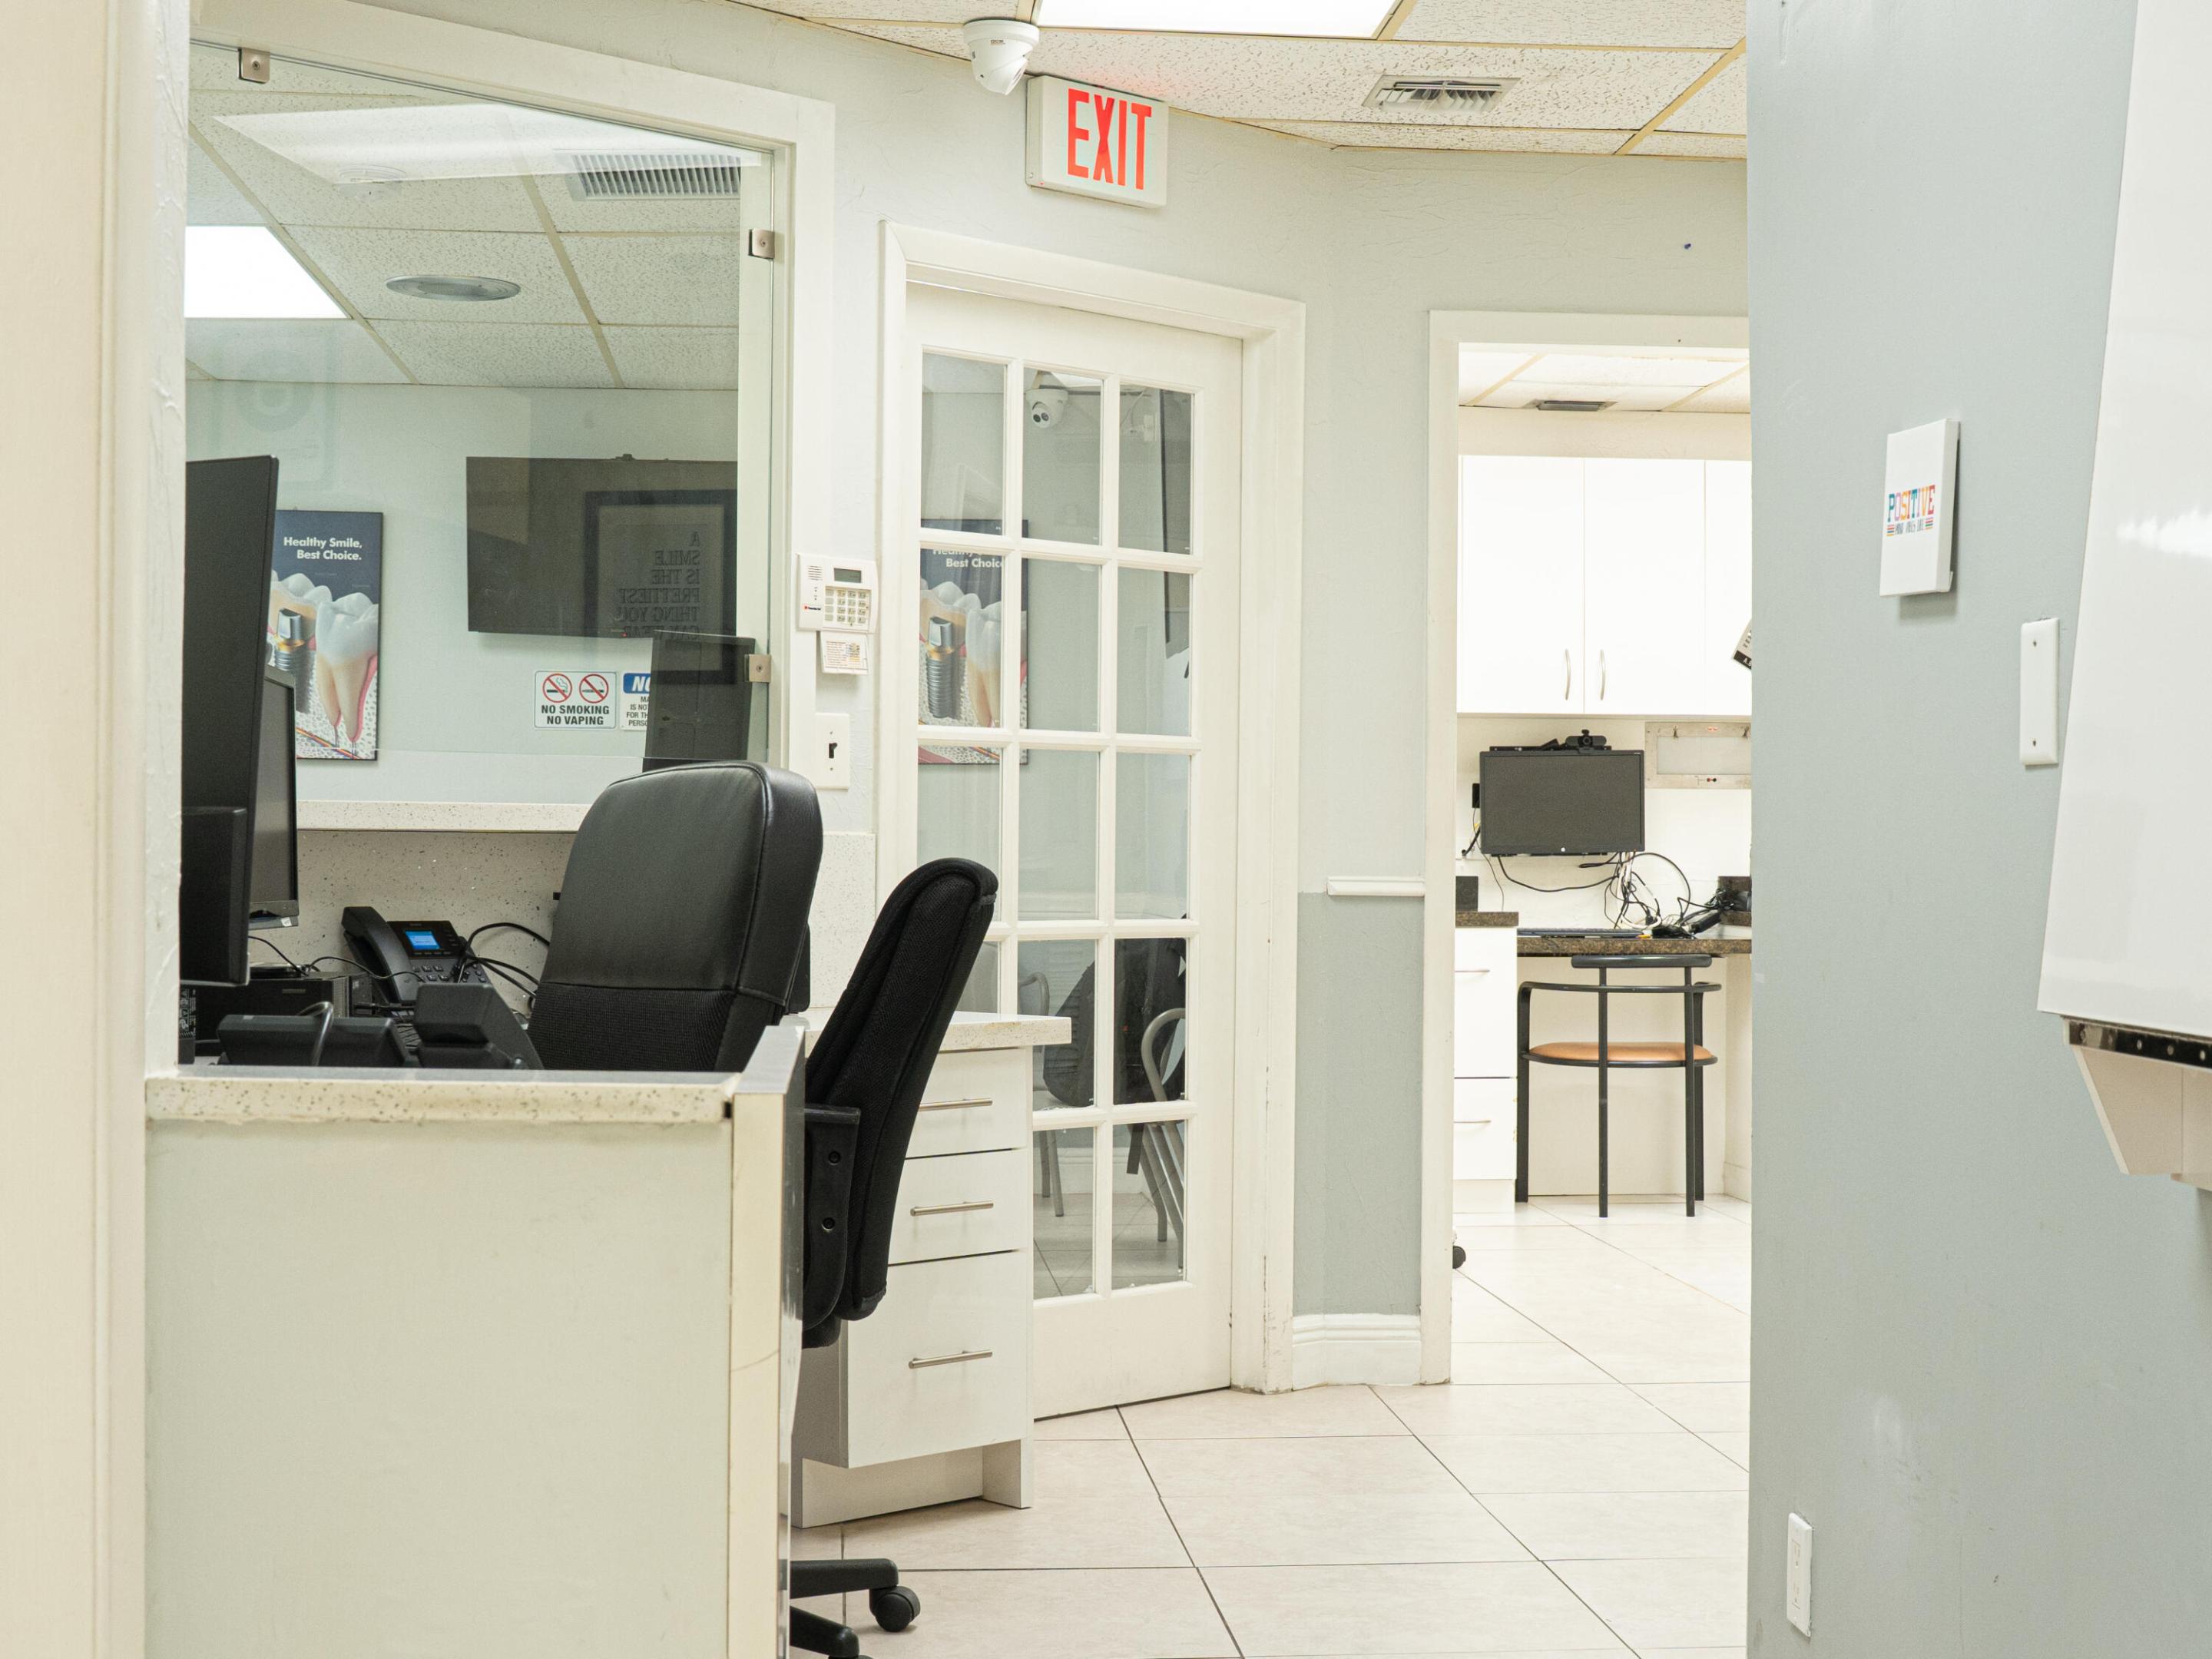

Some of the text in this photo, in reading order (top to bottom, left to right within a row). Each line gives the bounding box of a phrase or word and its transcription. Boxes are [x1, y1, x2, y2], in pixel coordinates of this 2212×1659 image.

[1068, 88, 1152, 190] EXIT
[1887, 485, 1936, 522] POSITIVE
[283, 536, 363, 549] Healthy Smile,
[296, 549, 362, 561] Best Choice.
[945, 558, 969, 568] Best
[541, 704, 610, 715] NO SMOKING
[547, 715, 604, 725] NO VAPING
